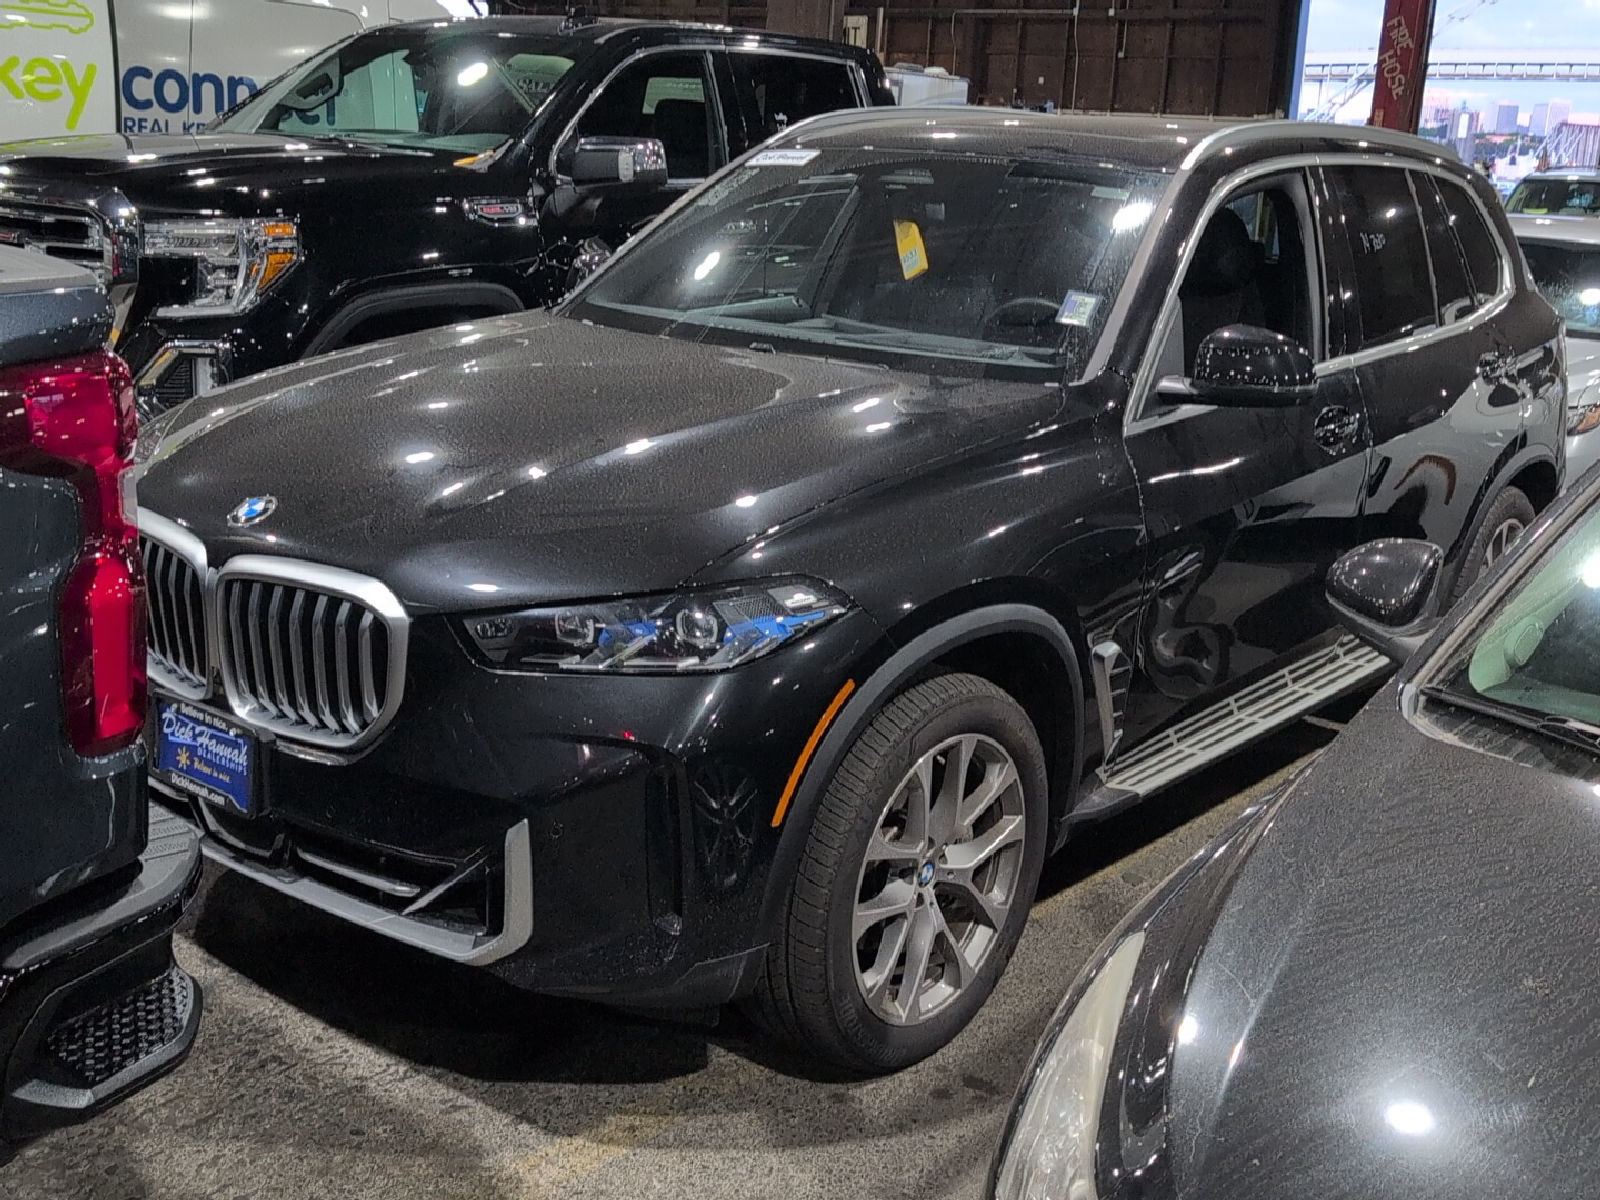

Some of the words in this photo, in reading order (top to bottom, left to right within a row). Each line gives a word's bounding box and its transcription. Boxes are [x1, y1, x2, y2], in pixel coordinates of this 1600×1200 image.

[1386, 16, 1415, 55] FIRE
[1379, 49, 1406, 100] HOSE
[162, 712, 195, 739] Dick
[194, 726, 248, 765] Hannah
[171, 772, 225, 806] DickHannah.com
